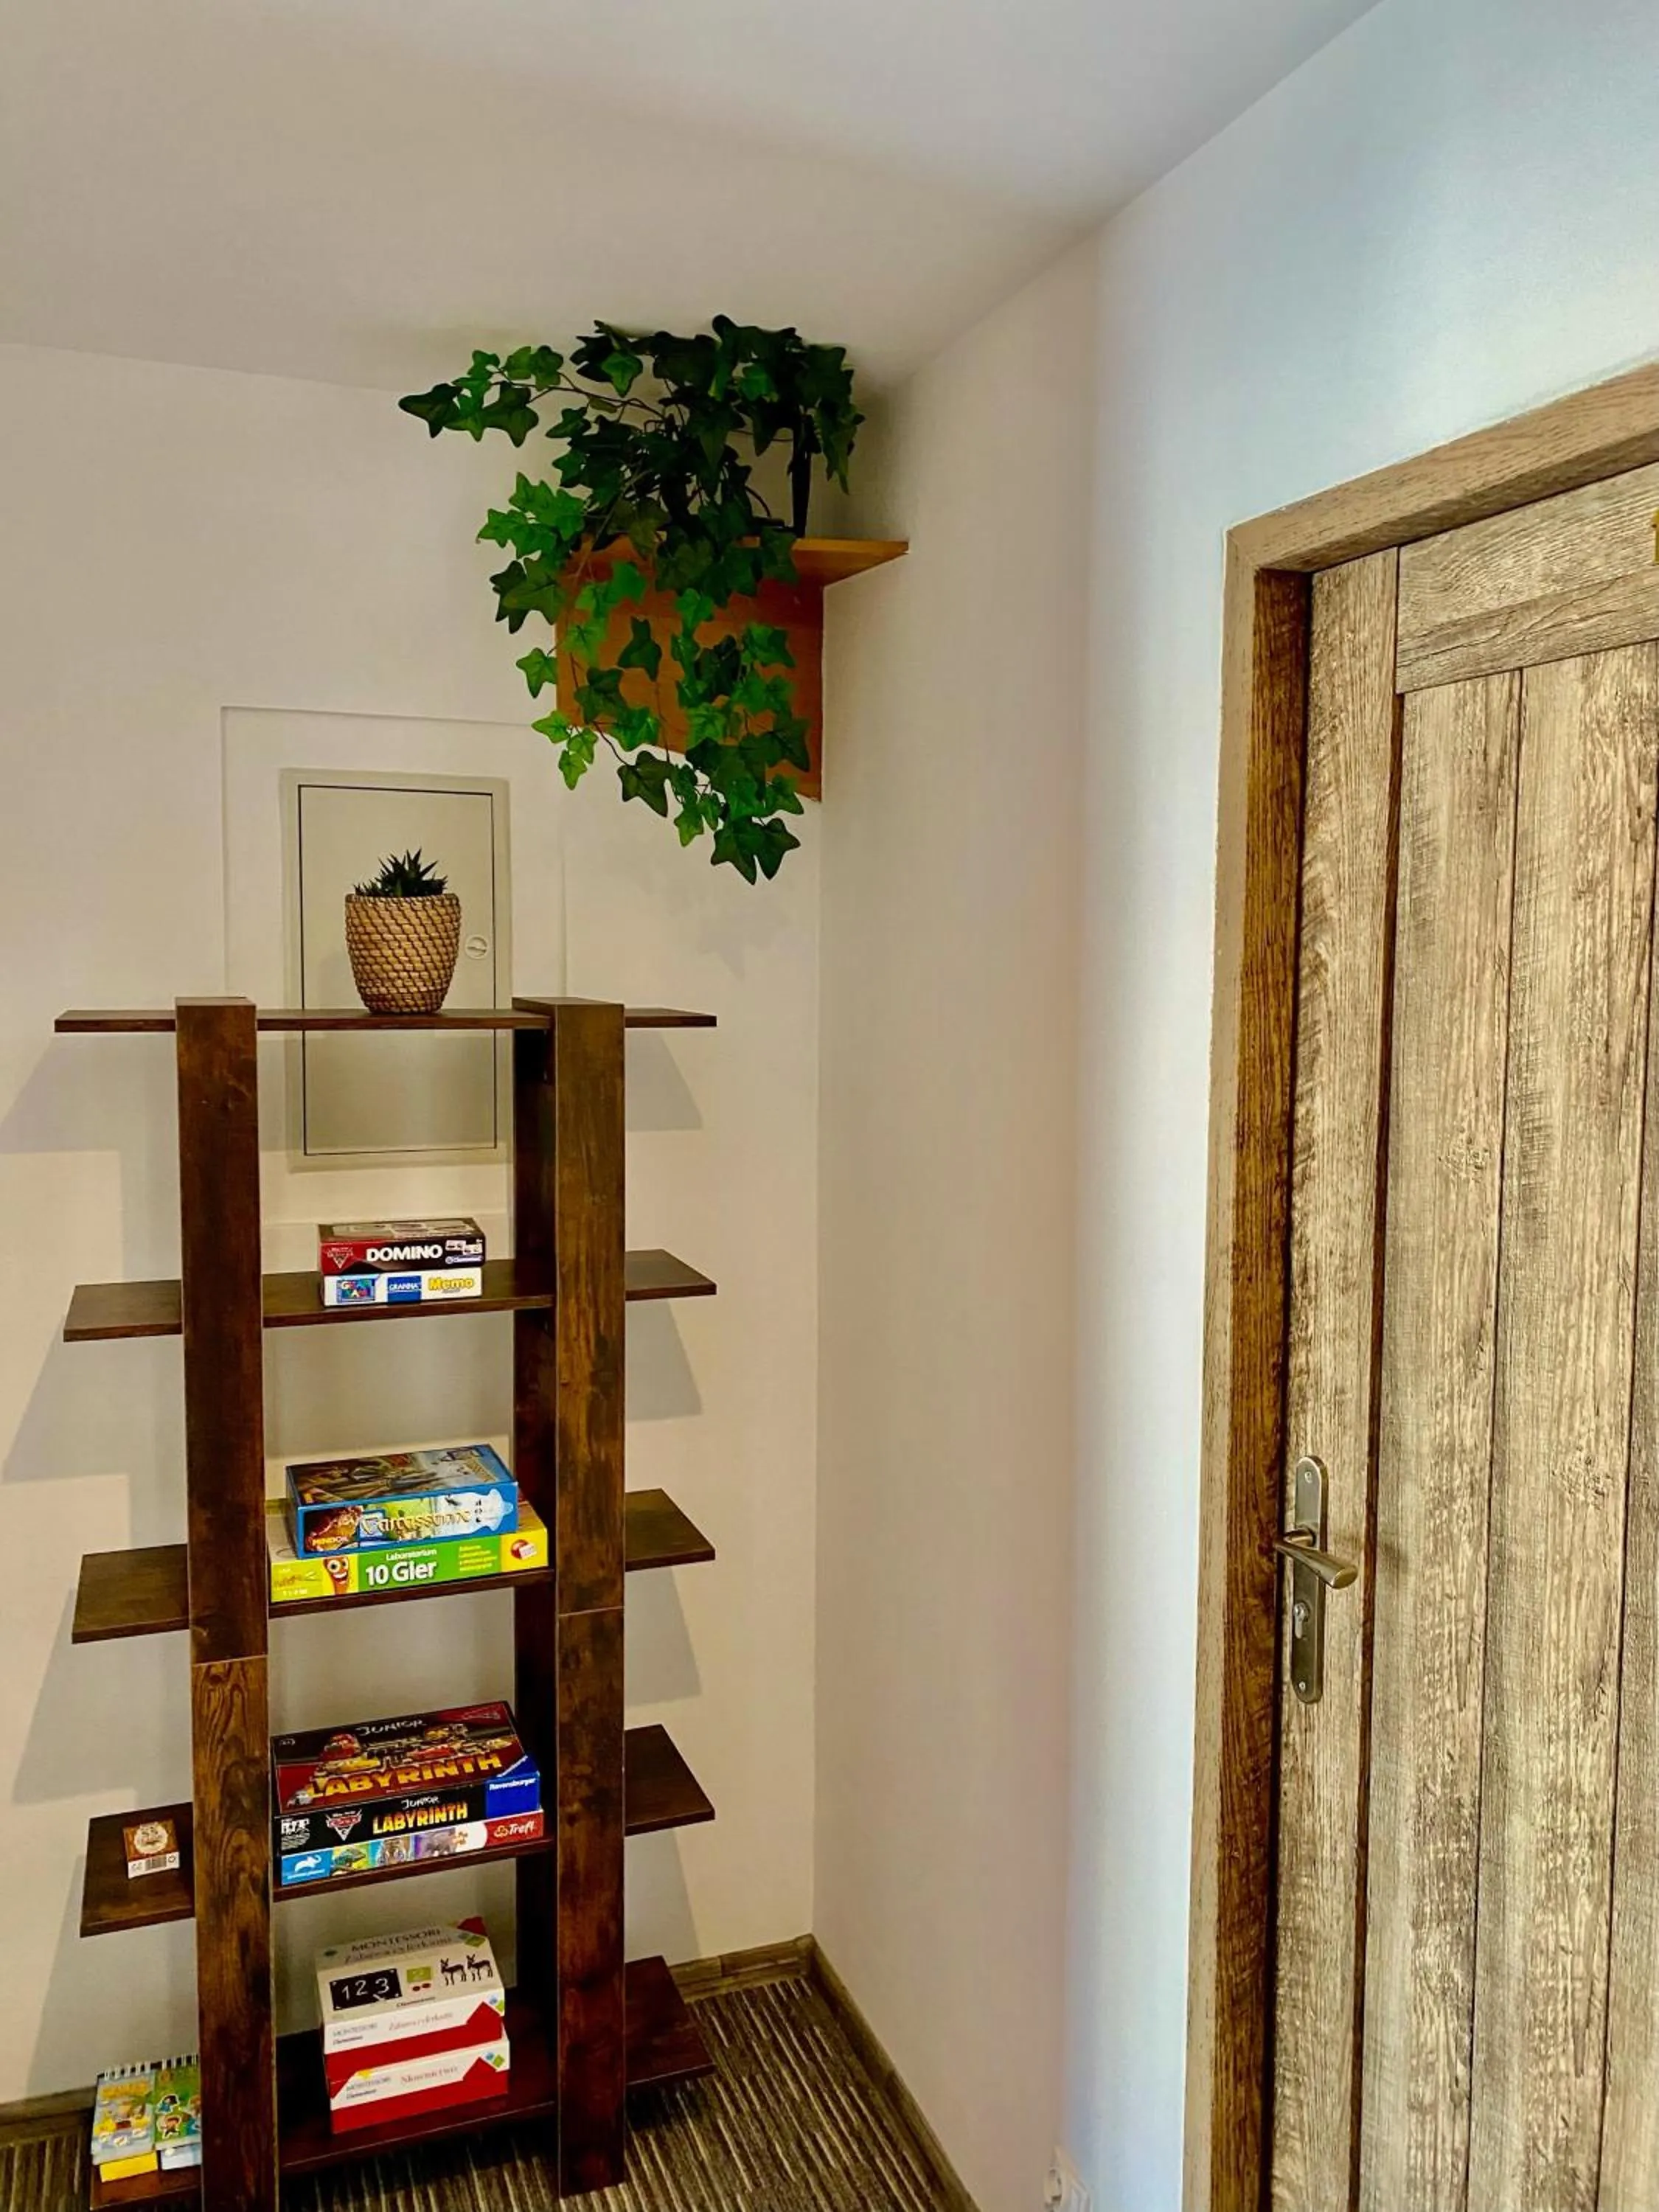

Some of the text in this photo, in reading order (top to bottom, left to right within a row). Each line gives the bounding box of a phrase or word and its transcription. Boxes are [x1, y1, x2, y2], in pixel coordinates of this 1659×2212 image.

[366, 1245, 443, 1262] DOMINO
[428, 1276, 474, 1290] Memo
[366, 1561, 437, 1585] 10 Gier
[355, 1719, 428, 1736] JUNIOR
[306, 1753, 503, 1799] LABYRINTH
[489, 1777, 537, 1790] Ravensburger
[401, 1795, 440, 1809] JUNIOR
[372, 1801, 468, 1835] LABYRINTH
